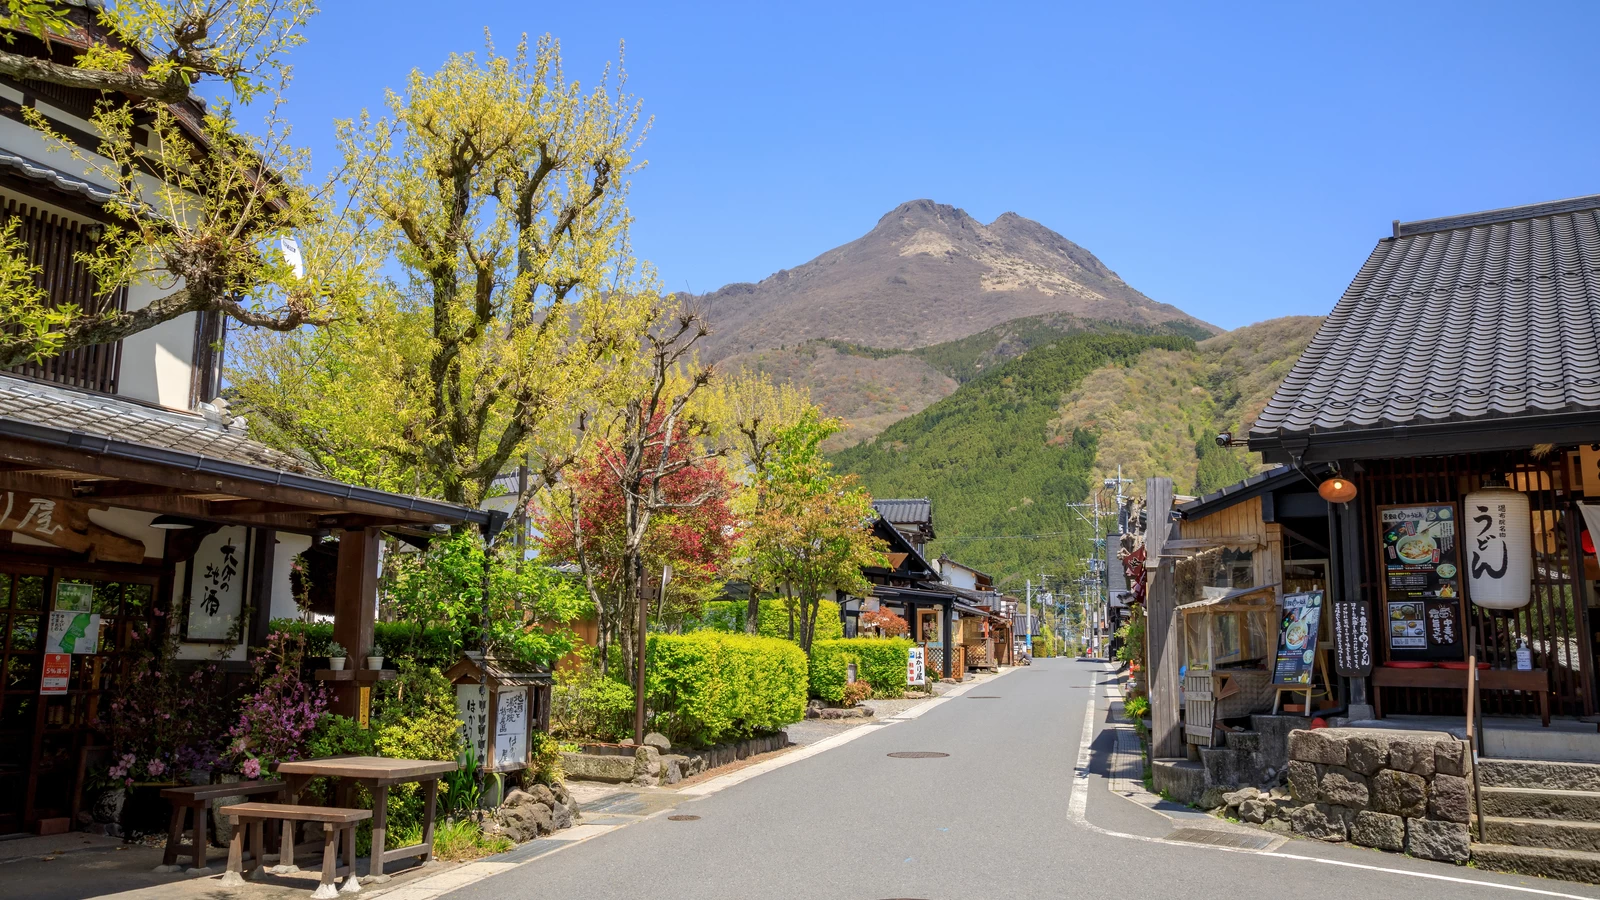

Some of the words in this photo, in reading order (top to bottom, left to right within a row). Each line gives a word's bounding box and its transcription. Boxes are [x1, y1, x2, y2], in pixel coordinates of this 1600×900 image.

[1498, 505, 1506, 538] 湯布院名物
[1472, 505, 1508, 579] うどん
[220, 537, 239, 593] 大分の
[200, 562, 220, 617] 地酒
[915, 651, 923, 681] はかり屋
[467, 700, 476, 739] はかり
[505, 697, 515, 722] 湯布院
[514, 692, 524, 718] 地酒と
[498, 749, 508, 764] 屋
[508, 736, 517, 758] はかり
